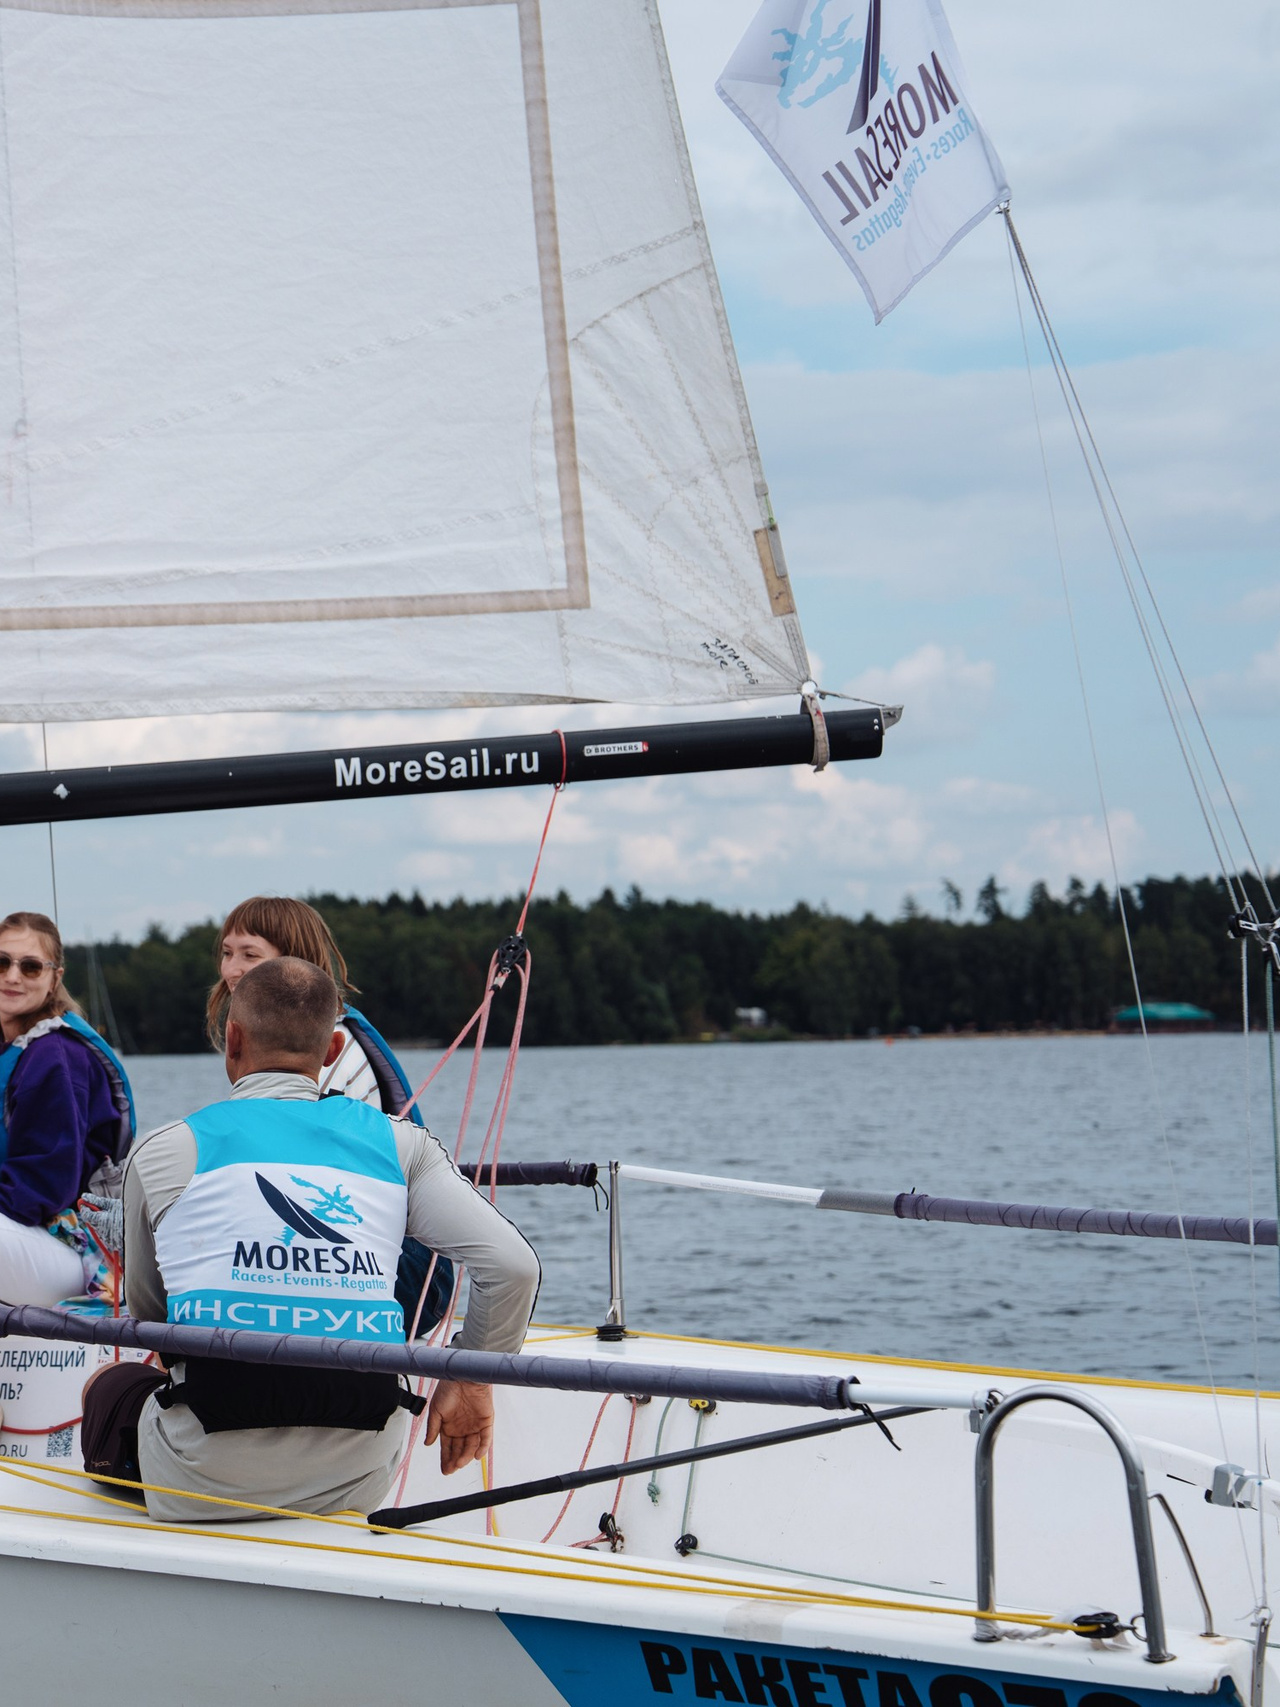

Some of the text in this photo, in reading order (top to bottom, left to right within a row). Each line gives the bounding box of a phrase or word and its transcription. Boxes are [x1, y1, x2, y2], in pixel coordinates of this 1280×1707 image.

[594, 744, 639, 754] BROTHERS
[334, 747, 540, 788] MoreSail.ru
[232, 1240, 385, 1276] MORESAIL
[231, 1268, 388, 1292] Races Events Regattas
